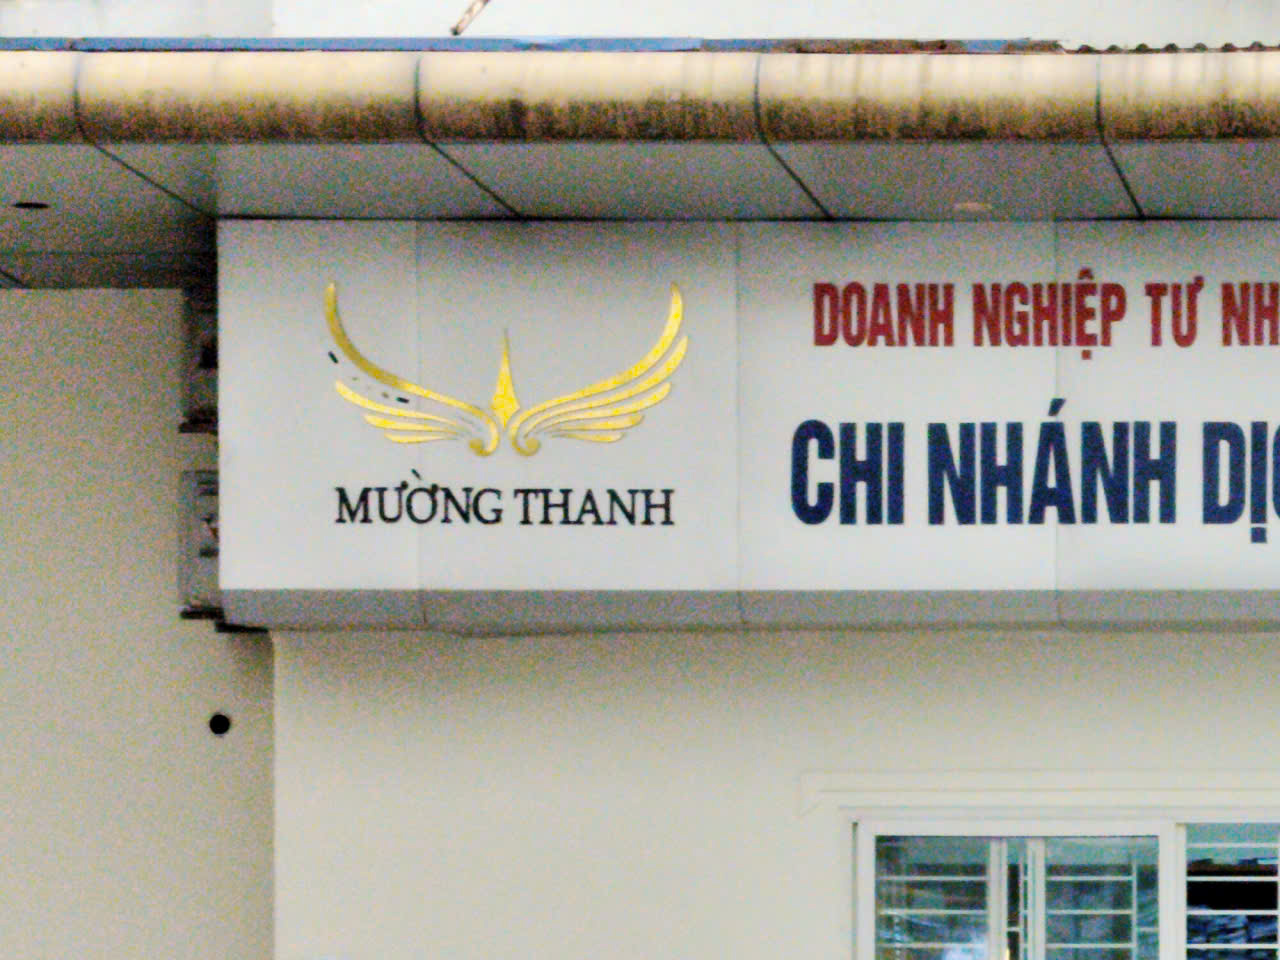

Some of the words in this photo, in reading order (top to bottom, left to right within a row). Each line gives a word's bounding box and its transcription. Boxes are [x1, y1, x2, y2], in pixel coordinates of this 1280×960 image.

[813, 281, 954, 347] DOANH
[973, 268, 1127, 360] NGHIỆP
[1145, 276, 1205, 347] TƯ
[335, 469, 503, 526] MƯỜNG
[514, 488, 675, 526] THANH
[791, 420, 905, 526] CHI
[927, 398, 1177, 525] NHÁNH
